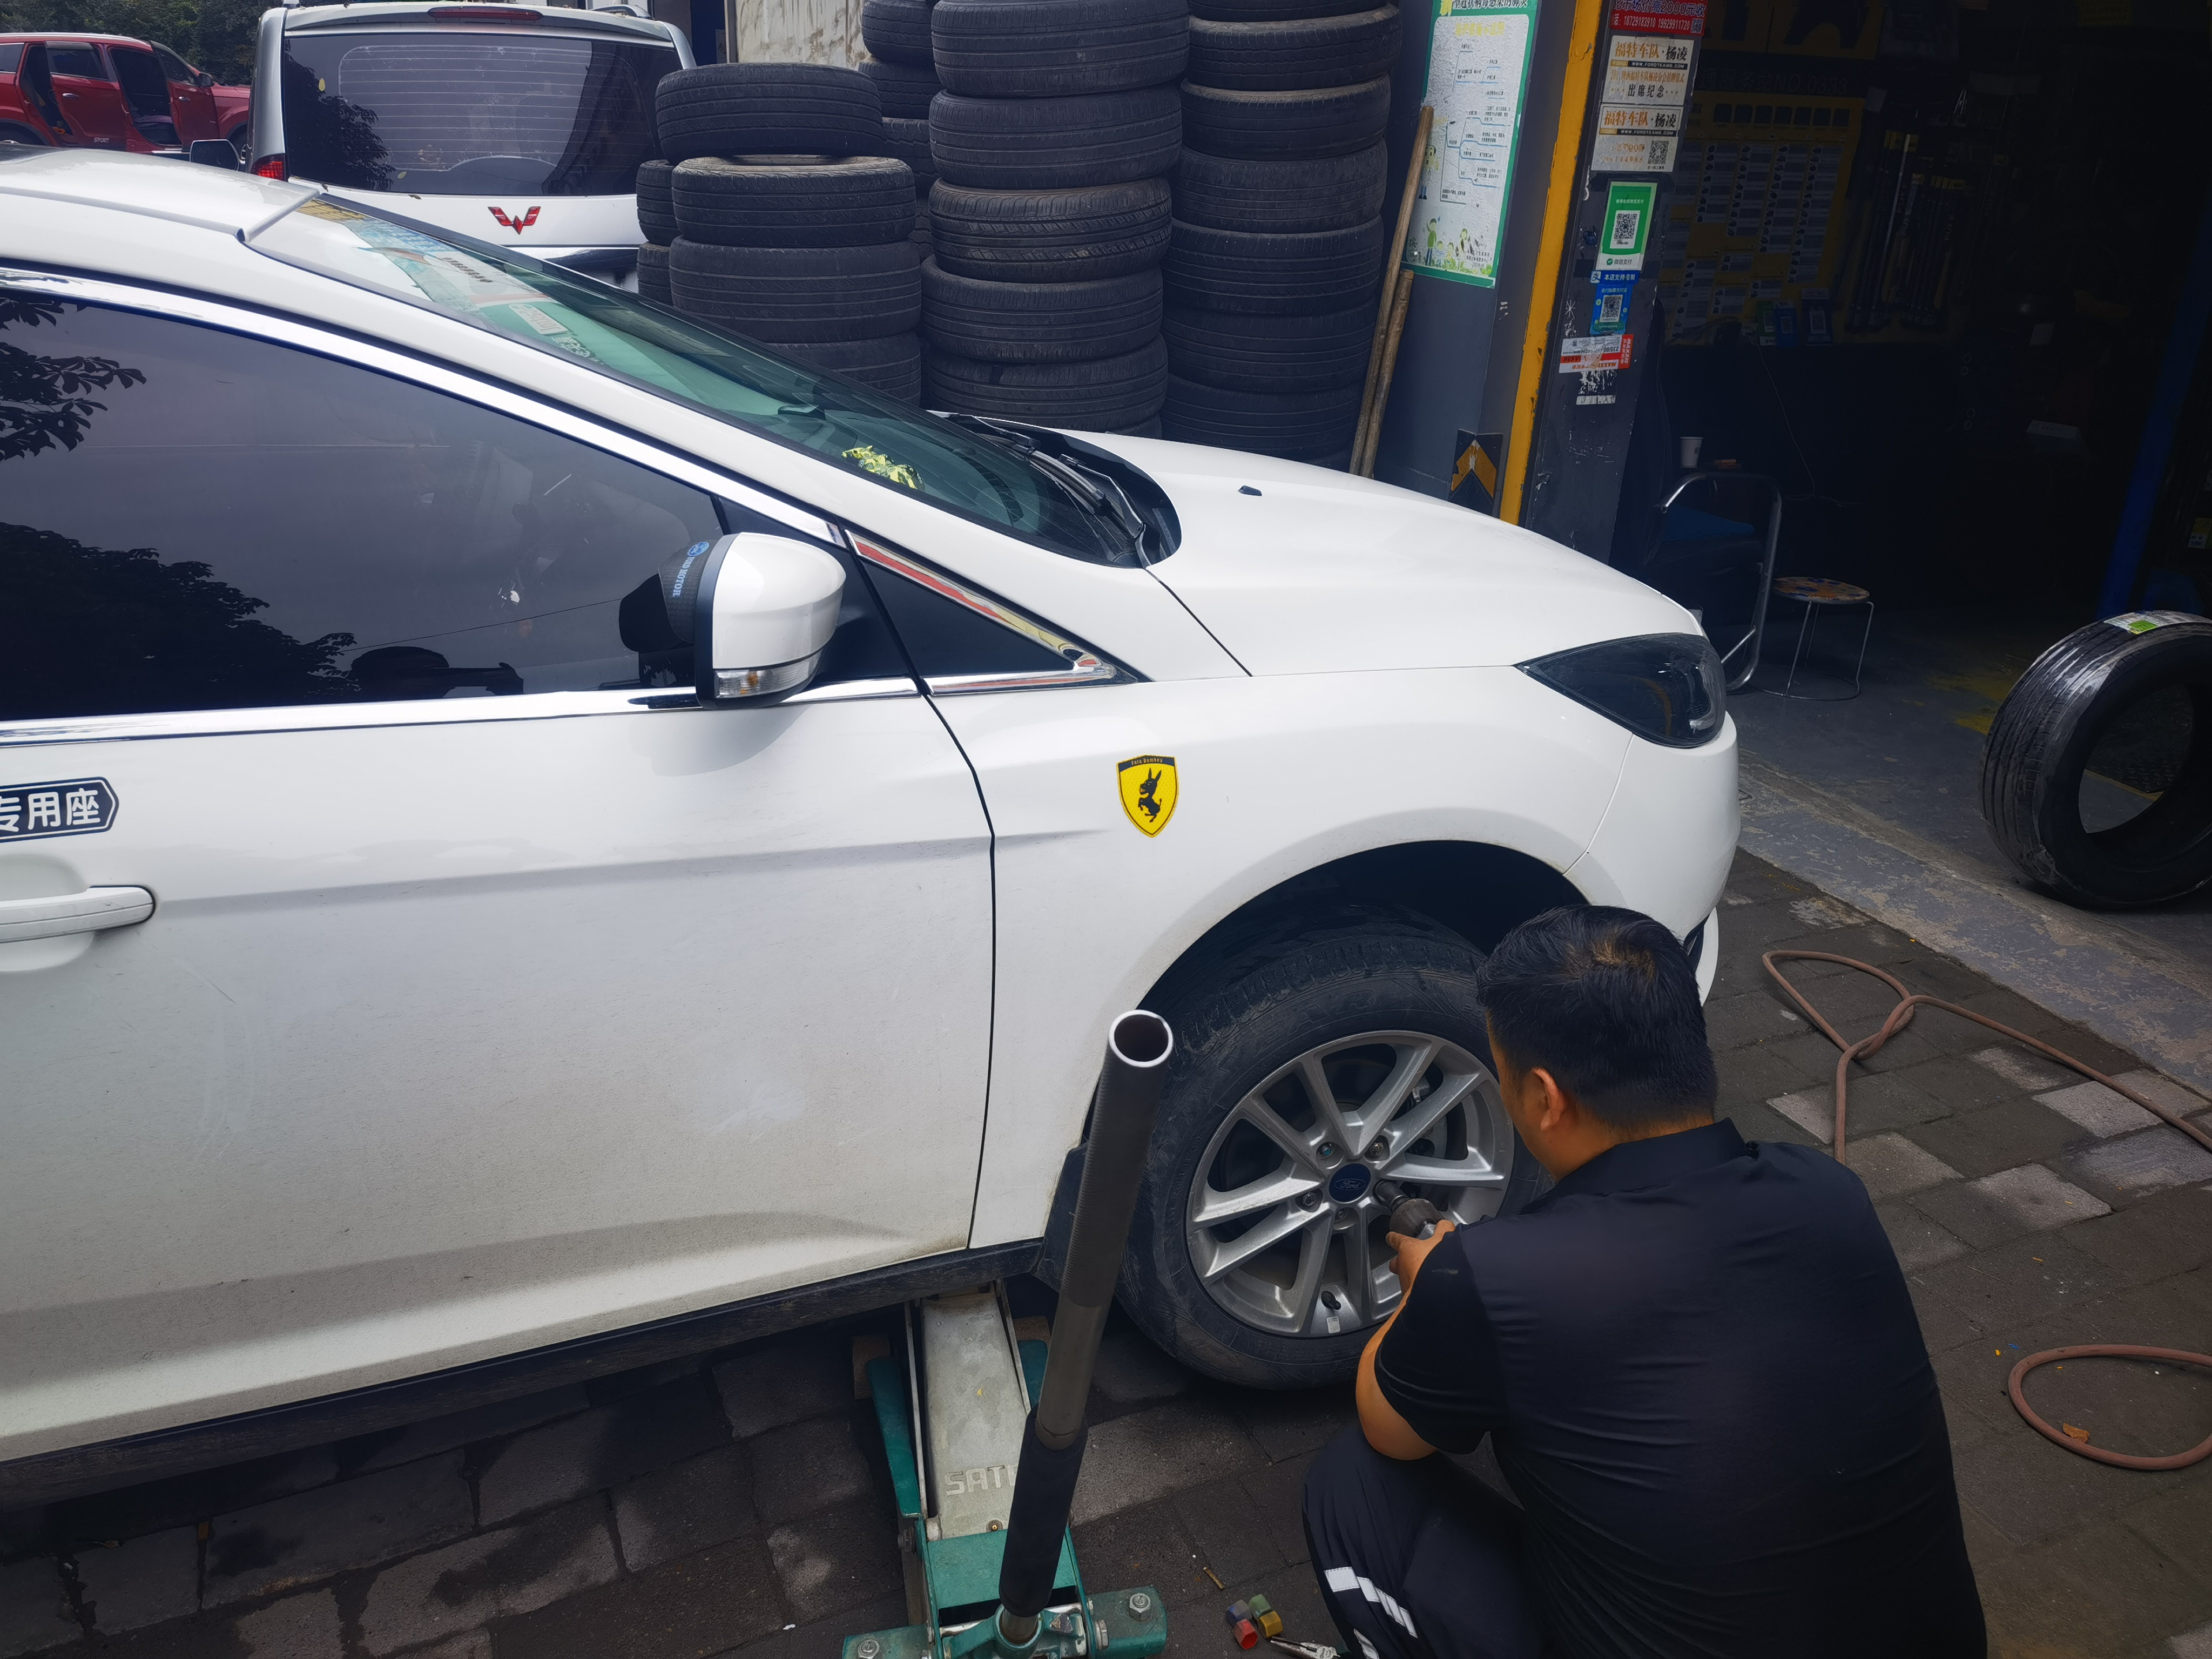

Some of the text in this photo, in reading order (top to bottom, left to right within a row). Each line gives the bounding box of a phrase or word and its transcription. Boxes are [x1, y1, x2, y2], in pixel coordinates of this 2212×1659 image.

[1628, 84, 1664, 98] 出席纪念
[672, 569, 688, 597] MOTOR
[1340, 1180, 1361, 1189] Ford
